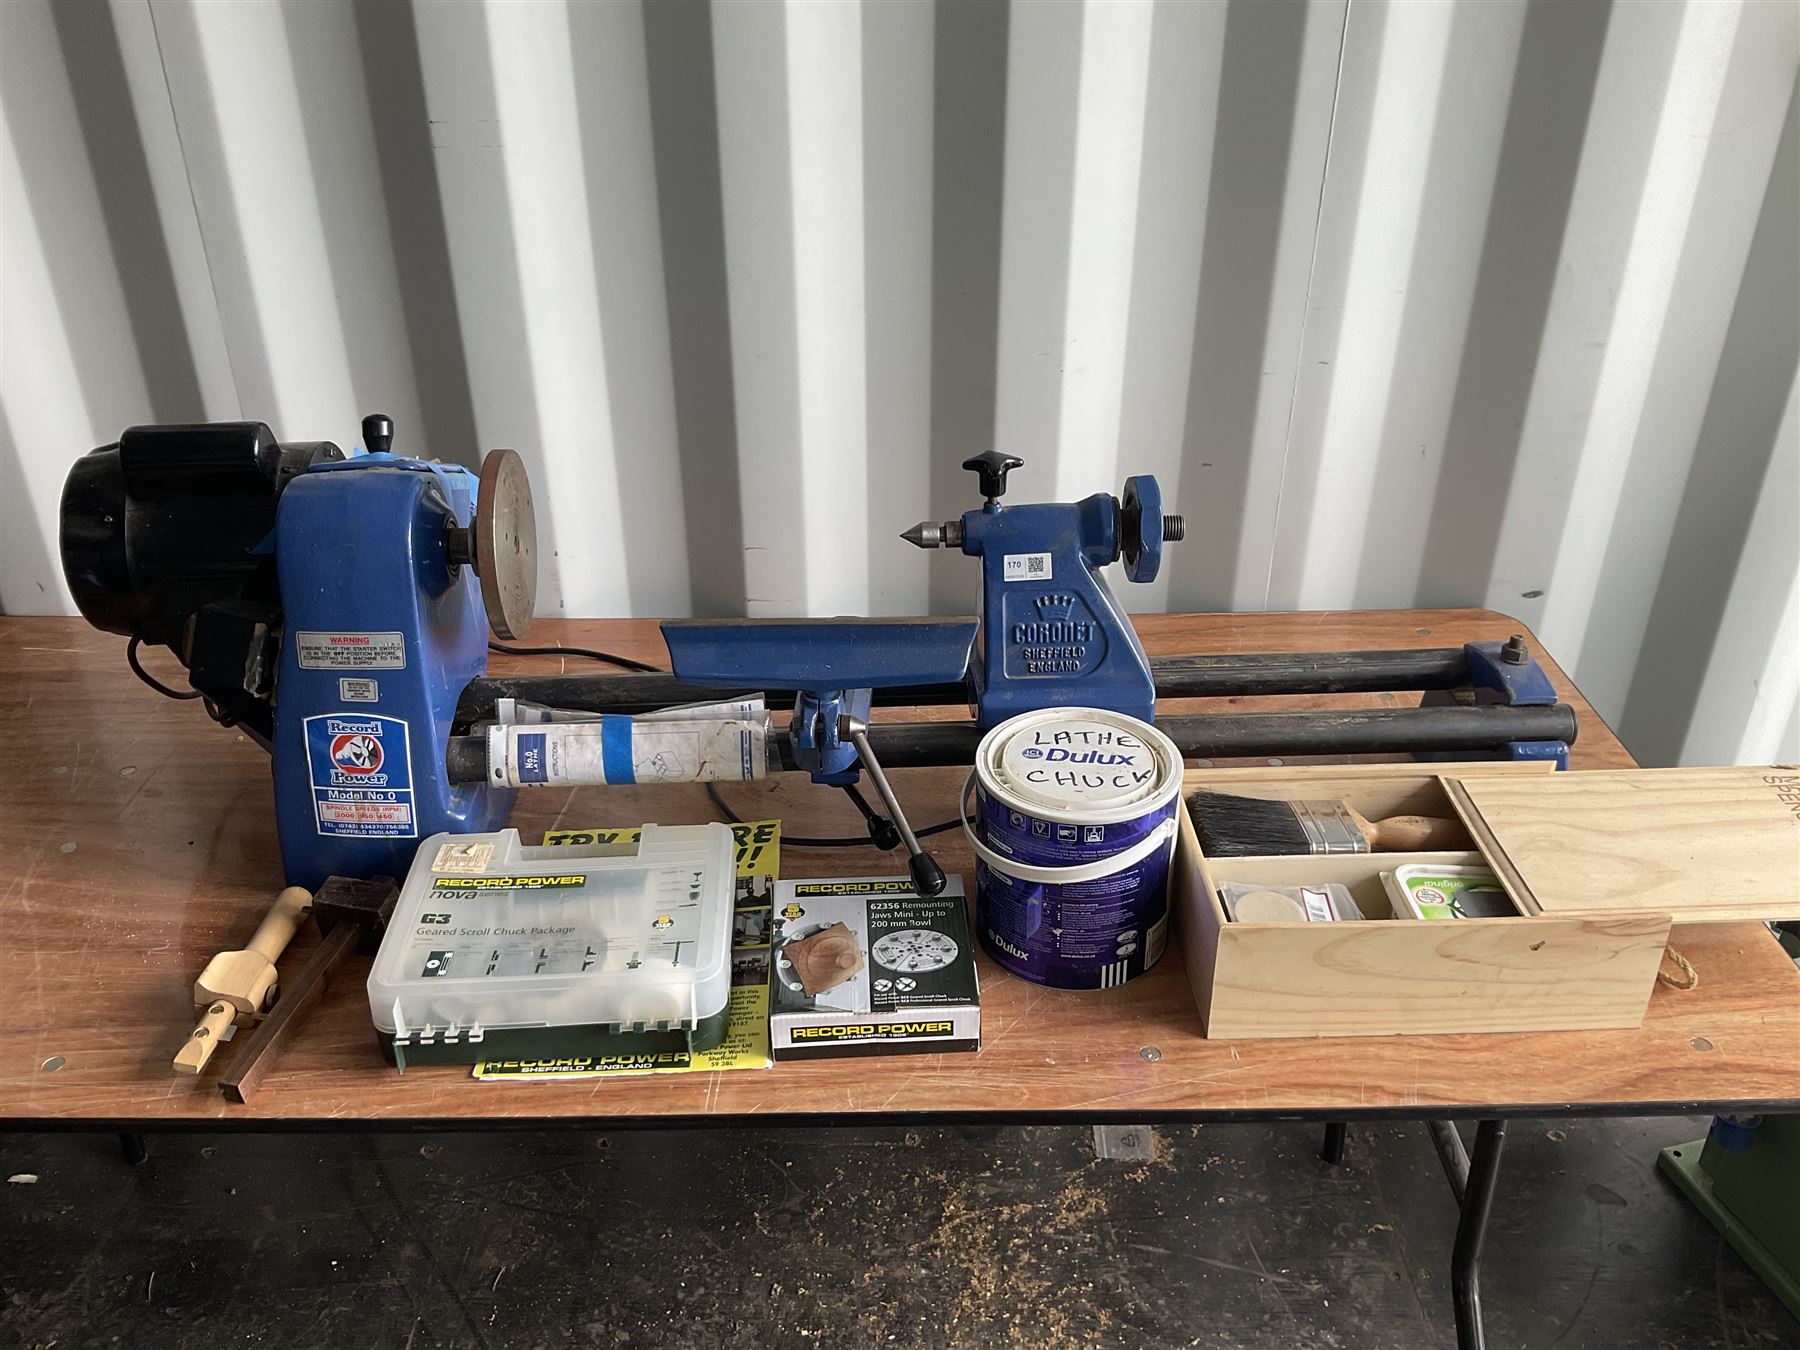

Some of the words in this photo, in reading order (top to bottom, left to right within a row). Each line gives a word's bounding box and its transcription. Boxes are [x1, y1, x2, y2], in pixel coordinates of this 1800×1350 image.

[1007, 561, 1021, 569] 170
[1013, 622, 1095, 644] CORONET
[330, 636, 369, 644] WARNING
[1023, 647, 1085, 660] SHEFFIELD
[1028, 660, 1080, 674] ENGLAND
[330, 722, 379, 732] Record
[1034, 730, 1141, 748] LATHE
[525, 751, 533, 769] No.0
[1045, 748, 1136, 766] Dulux
[334, 771, 385, 783] Power
[1026, 769, 1151, 788] CHUCK
[328, 790, 363, 800] Model
[368, 791, 384, 801] No
[436, 879, 513, 887] RECORD
[516, 876, 585, 886] POWER
[797, 883, 870, 893] RECORD
[873, 881, 915, 891] POW
[1424, 880, 1464, 889] original
[429, 890, 478, 900] nova
[902, 901, 954, 911] Remounting
[420, 913, 451, 925] G3
[871, 912, 892, 920] Jaws
[922, 911, 935, 919] Up
[909, 919, 932, 927] Bowl
[416, 927, 457, 936] Geared
[460, 927, 490, 936] Scroll
[494, 927, 527, 936] Chuck
[530, 926, 576, 936] Package
[995, 934, 1029, 961] Dulux
[793, 1026, 875, 1038] RECORD
[878, 1022, 952, 1033] POWER
[600, 1052, 690, 1065] POWER
[595, 1063, 653, 1071] ENGLAND
